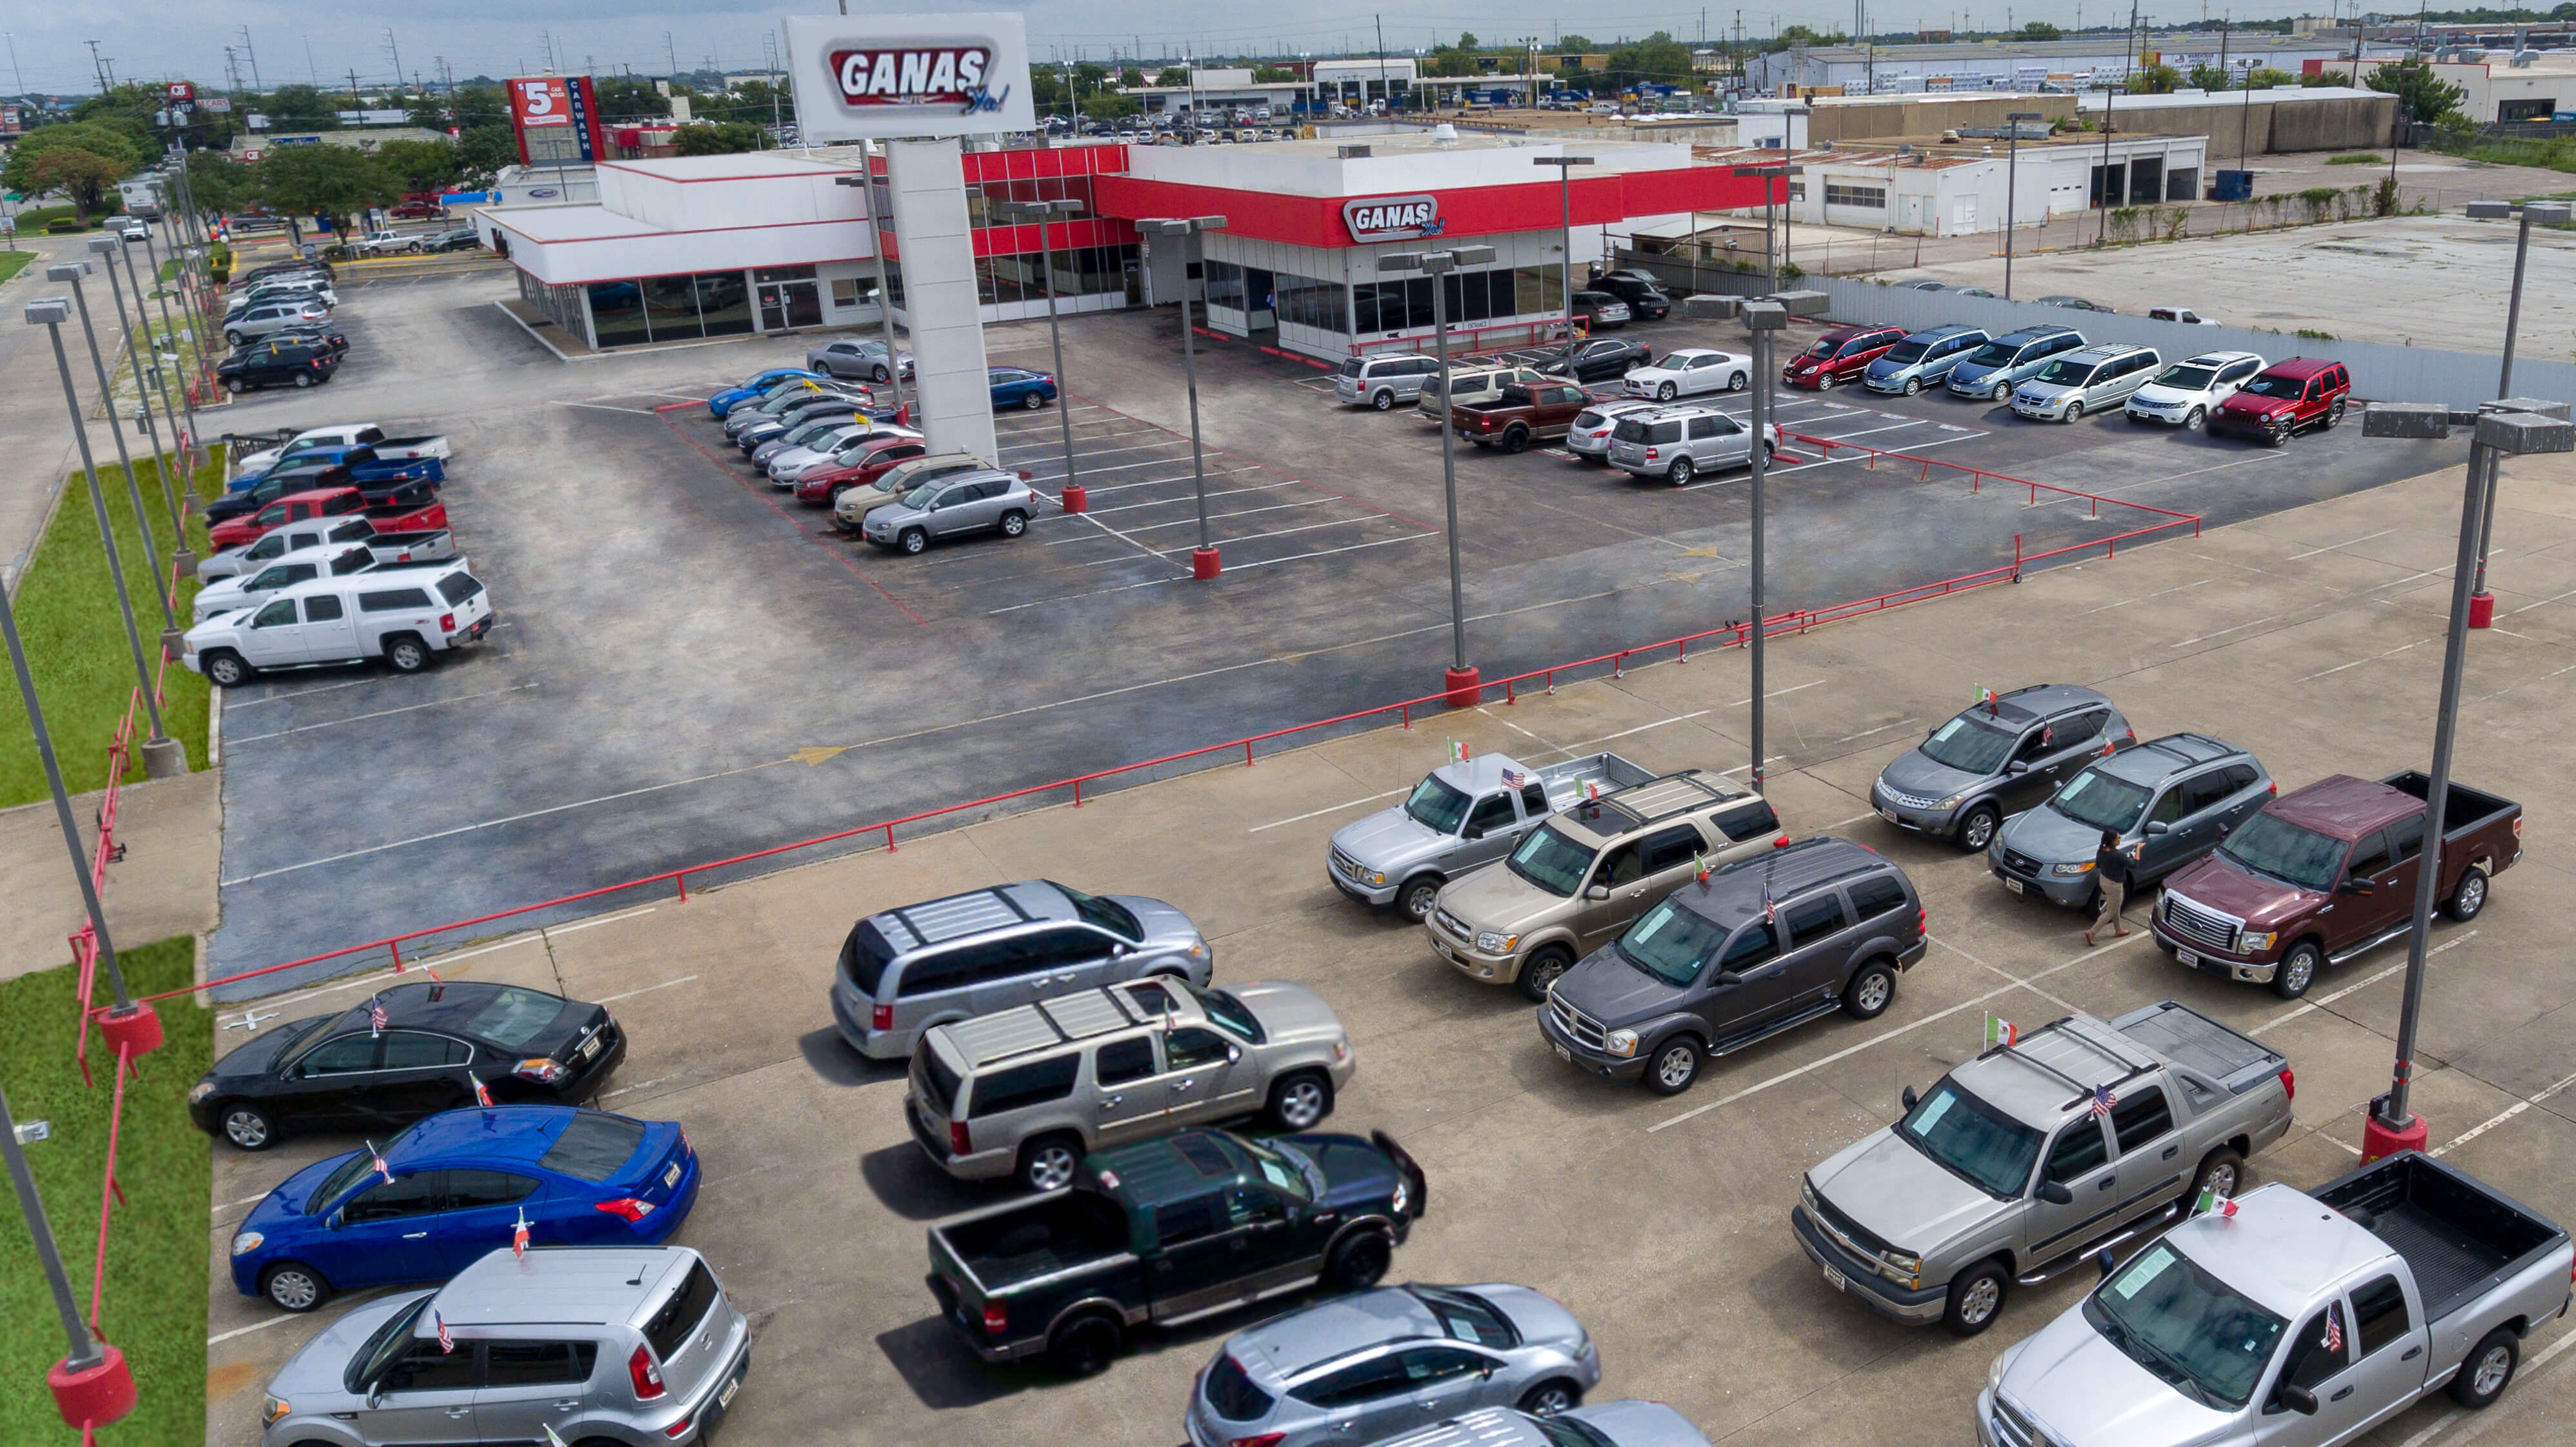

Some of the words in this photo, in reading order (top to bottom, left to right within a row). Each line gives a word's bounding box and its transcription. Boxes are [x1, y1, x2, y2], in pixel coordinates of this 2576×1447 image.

[840, 50, 984, 96] GANAS
[171, 85, 186, 96] QT
[1356, 203, 1429, 229] GANAS
